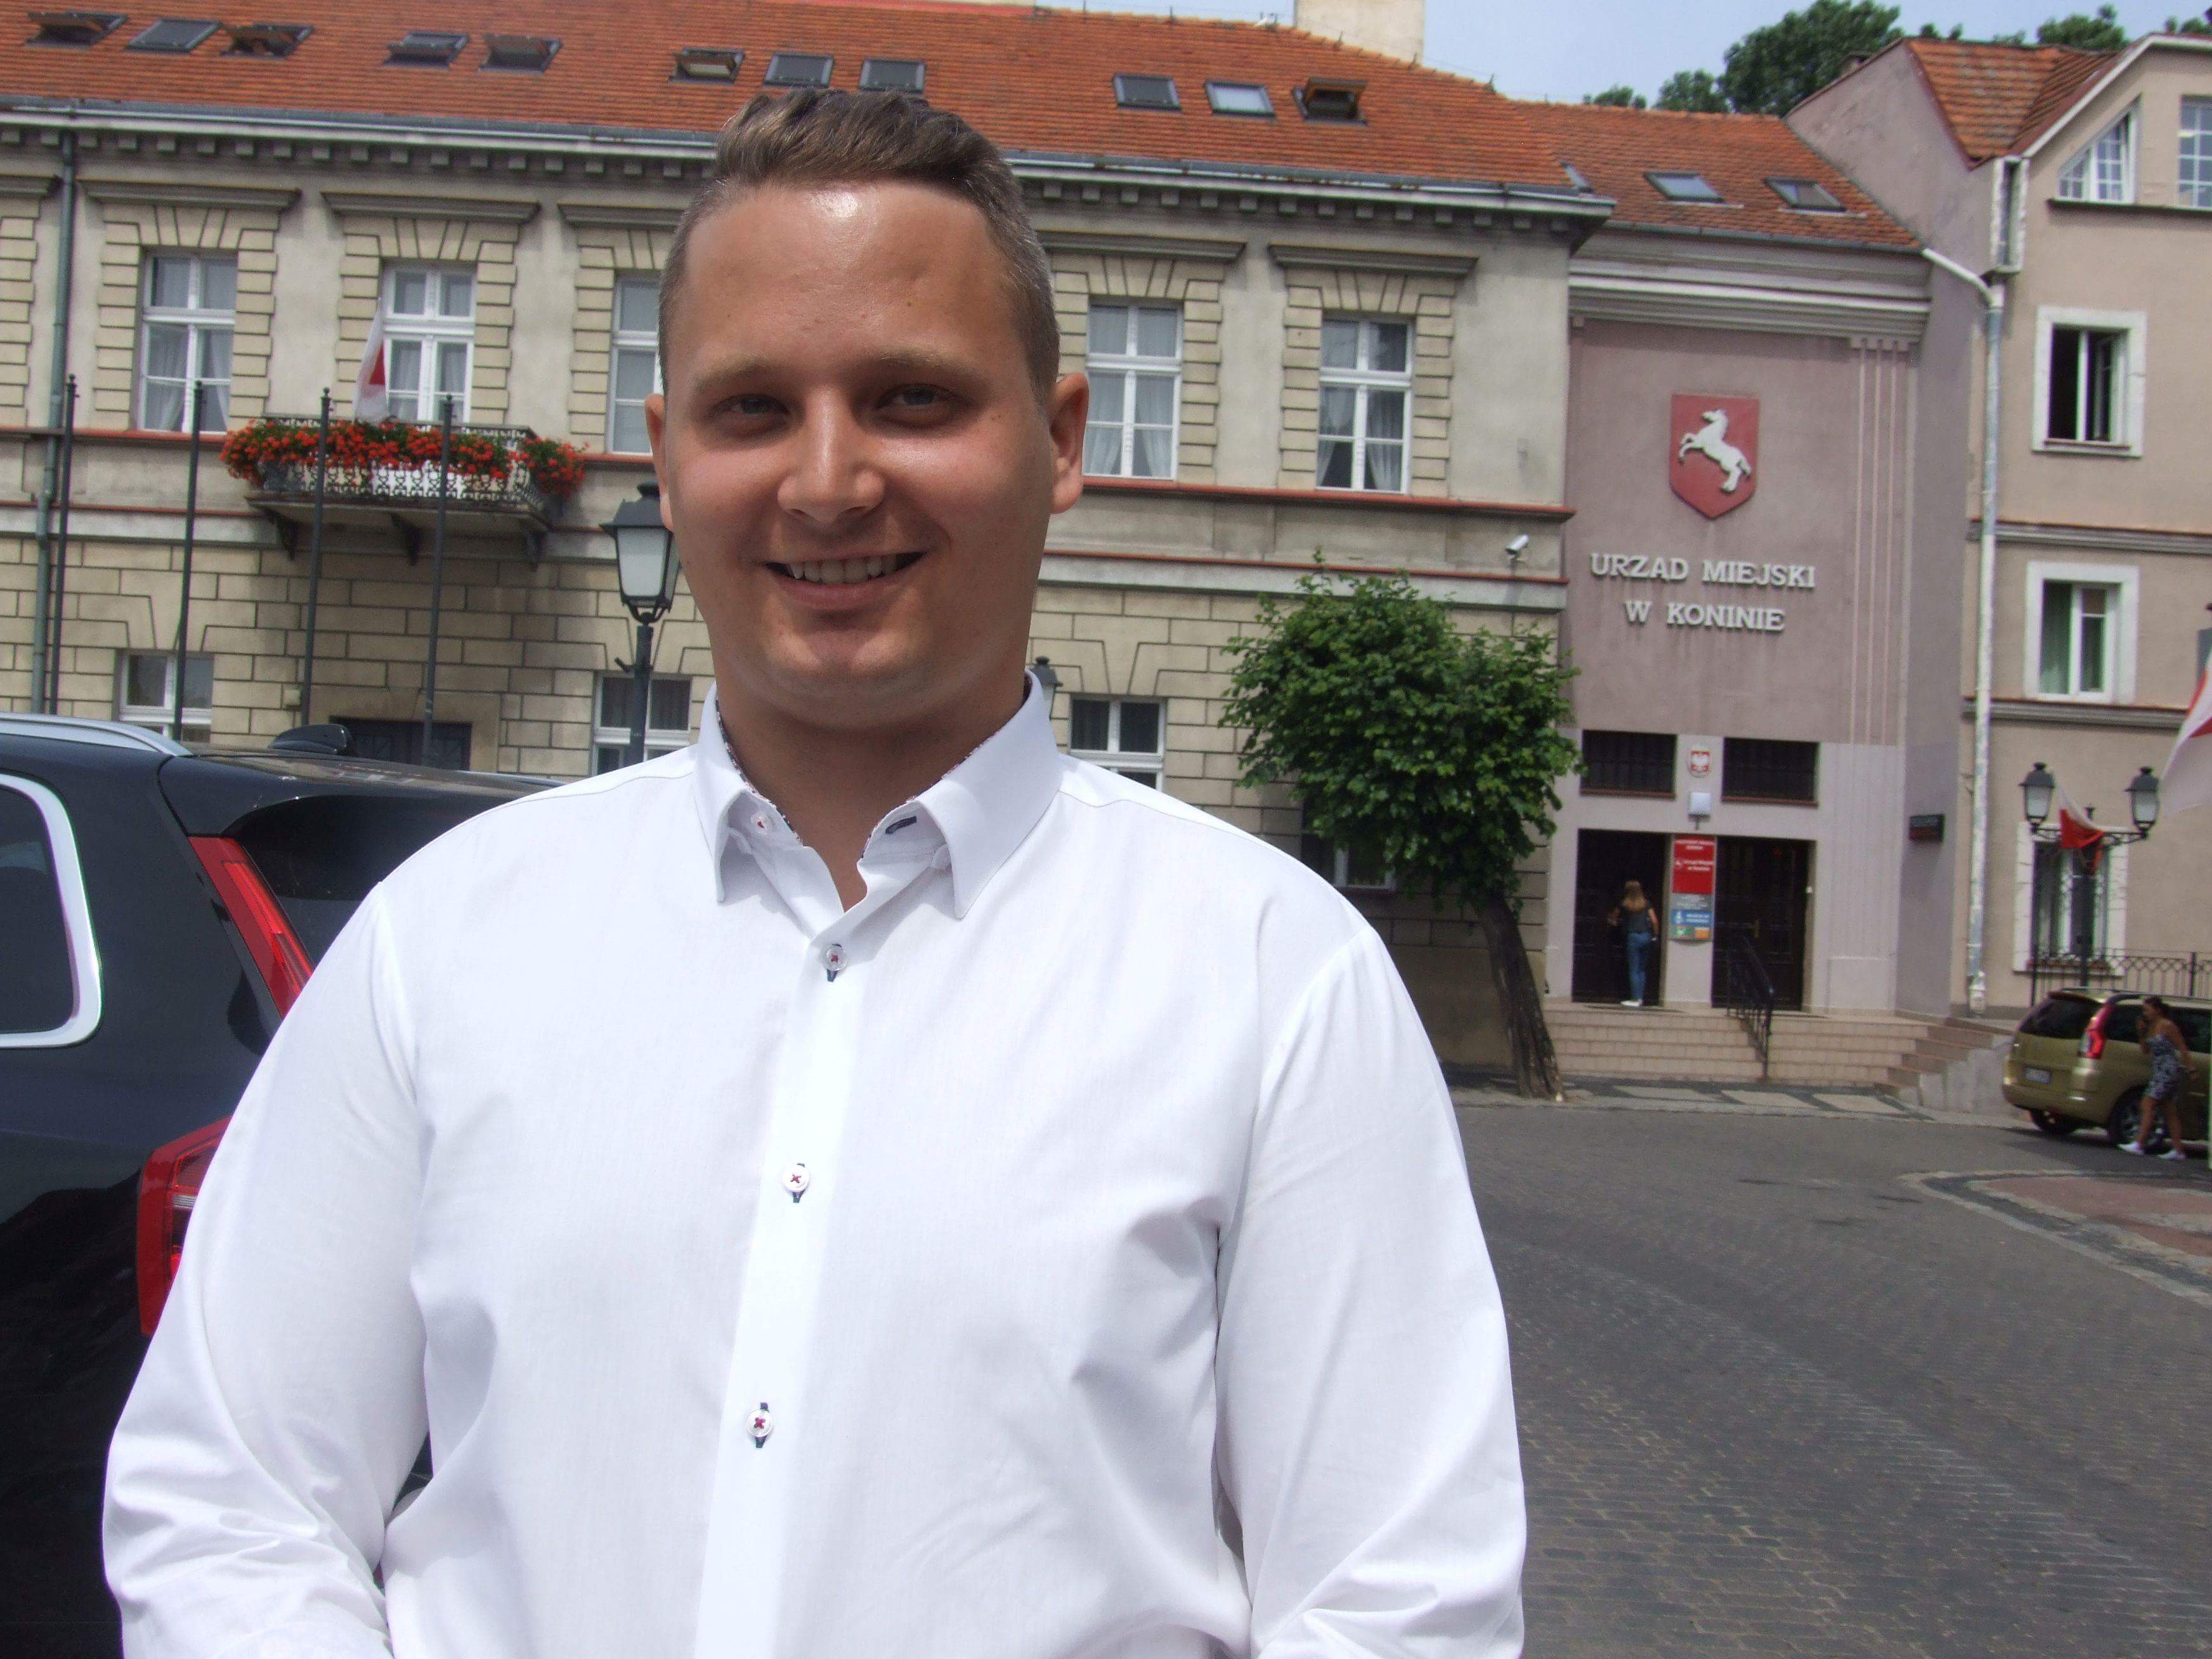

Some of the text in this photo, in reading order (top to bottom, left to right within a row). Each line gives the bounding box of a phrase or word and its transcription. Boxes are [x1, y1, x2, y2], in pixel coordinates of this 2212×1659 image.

[1701, 560, 1816, 589] MIEJSKI
[1625, 600, 1785, 632] W KONINIE
